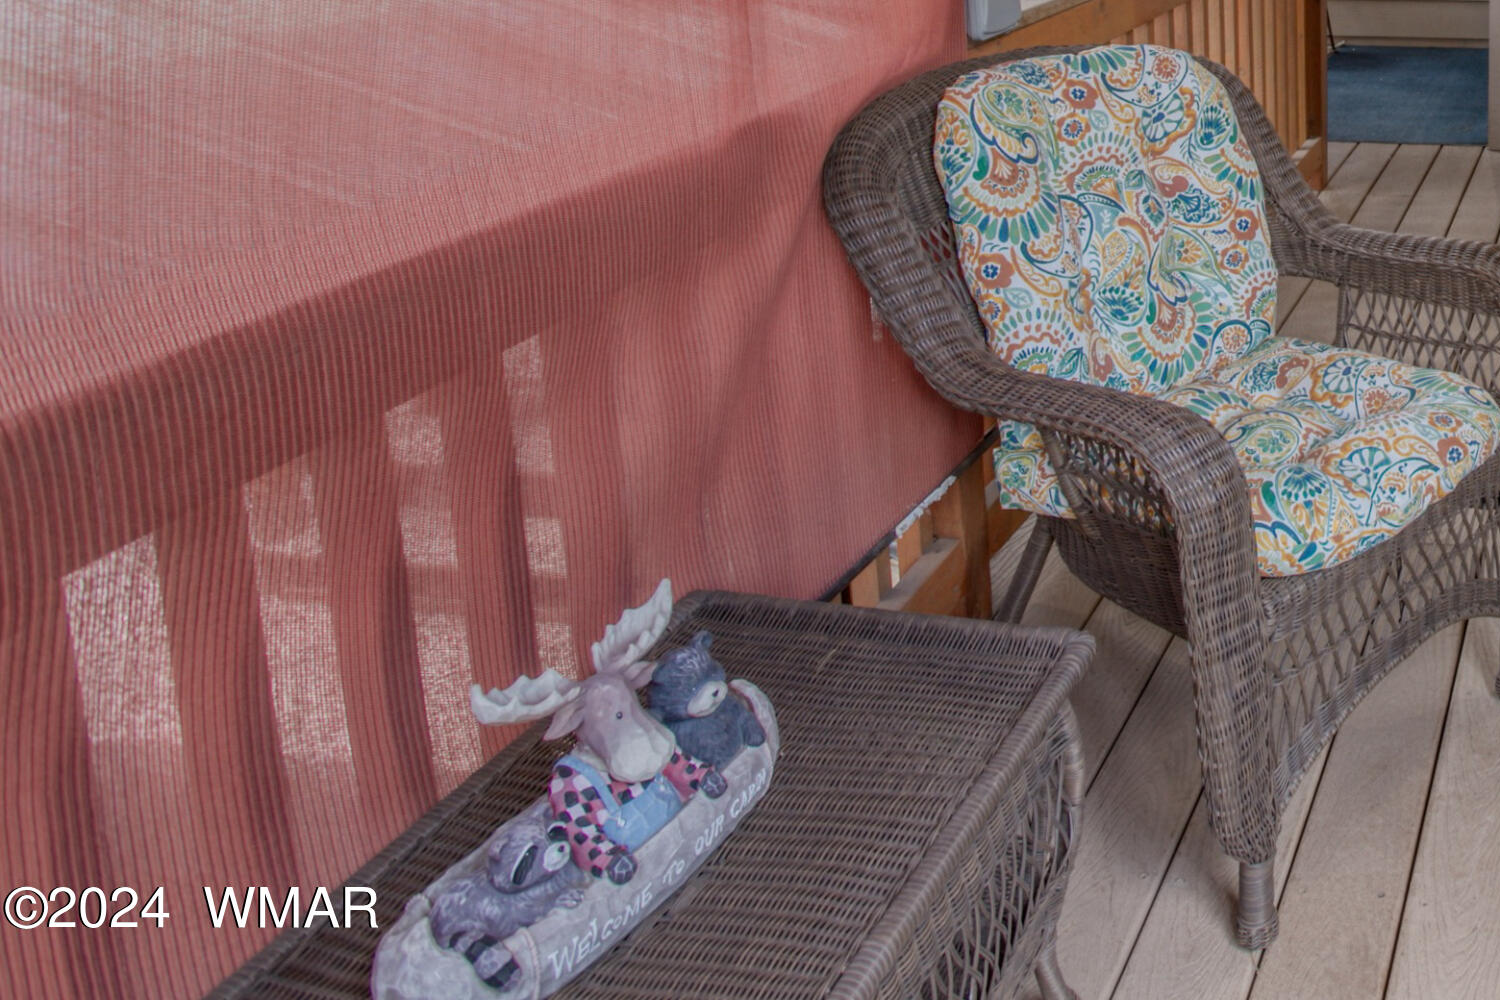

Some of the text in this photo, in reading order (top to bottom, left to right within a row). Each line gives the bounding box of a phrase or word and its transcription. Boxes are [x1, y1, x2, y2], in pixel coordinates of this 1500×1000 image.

[548, 882, 653, 980] WELCOME
[662, 859, 686, 885] TO
[695, 813, 725, 857] OUR
